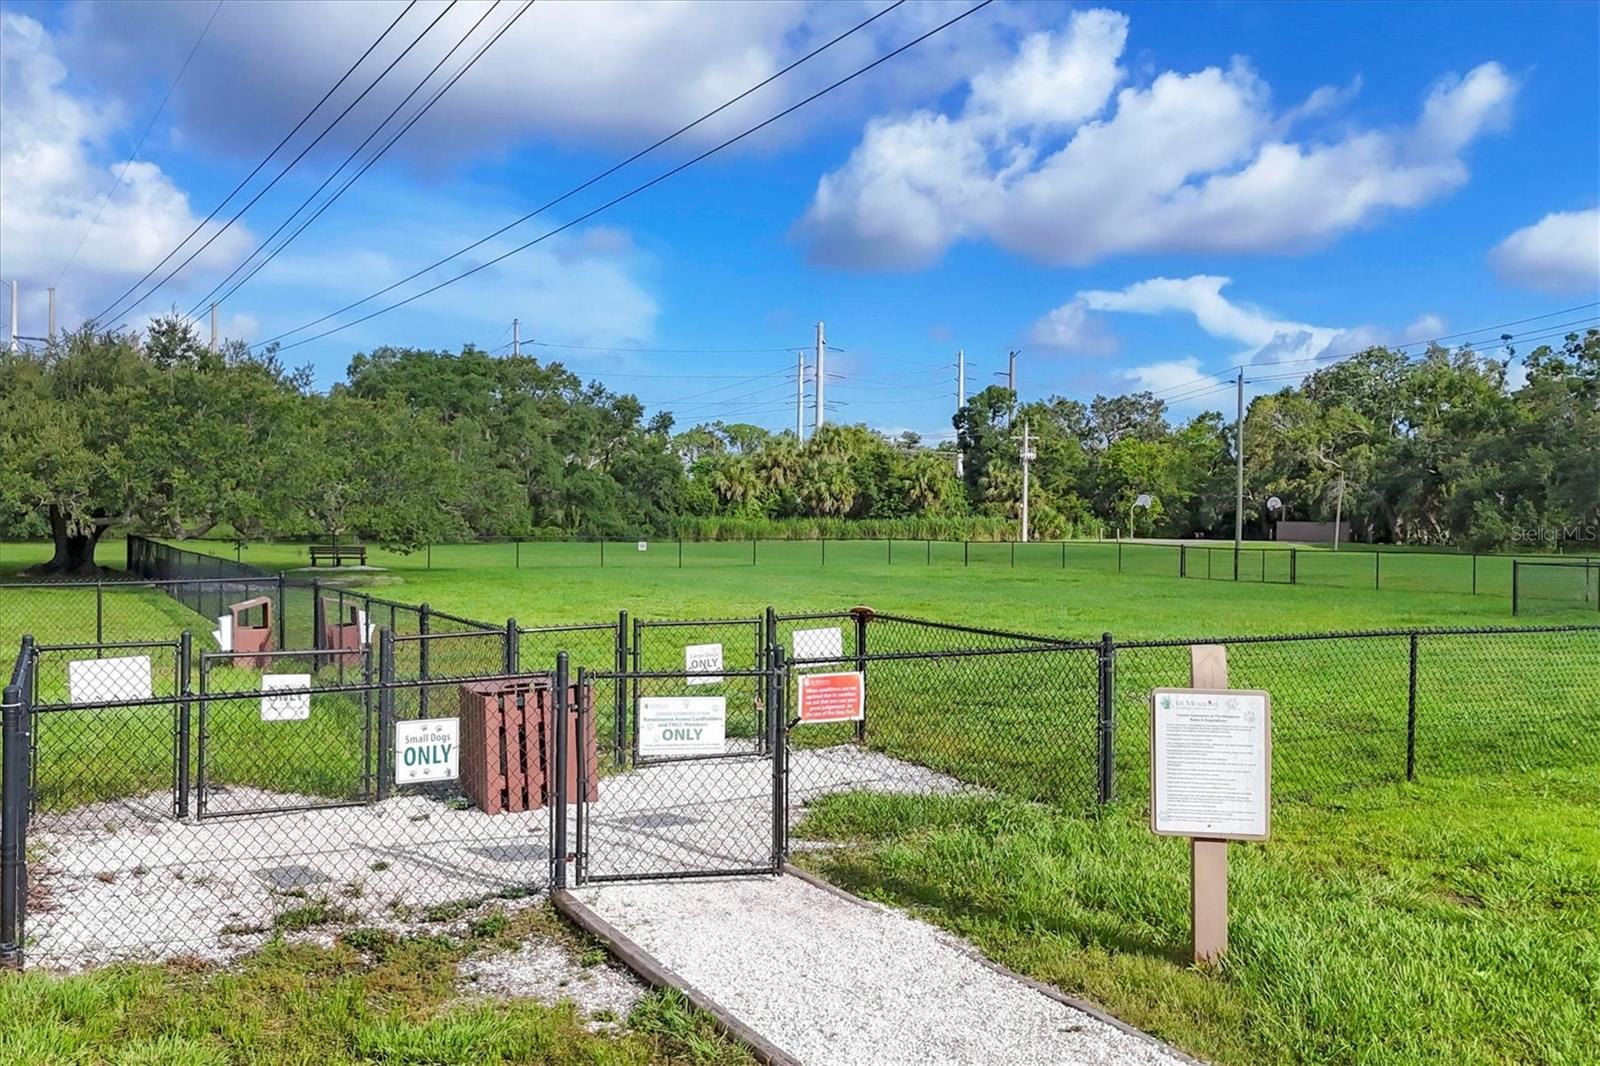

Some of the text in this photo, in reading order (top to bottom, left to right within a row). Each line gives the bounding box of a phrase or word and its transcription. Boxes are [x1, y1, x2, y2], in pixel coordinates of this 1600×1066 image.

[691, 658, 718, 669] ONLY
[405, 733, 451, 744] Small Dogs
[662, 728, 703, 741] ONLY
[404, 744, 452, 767] ONLY
